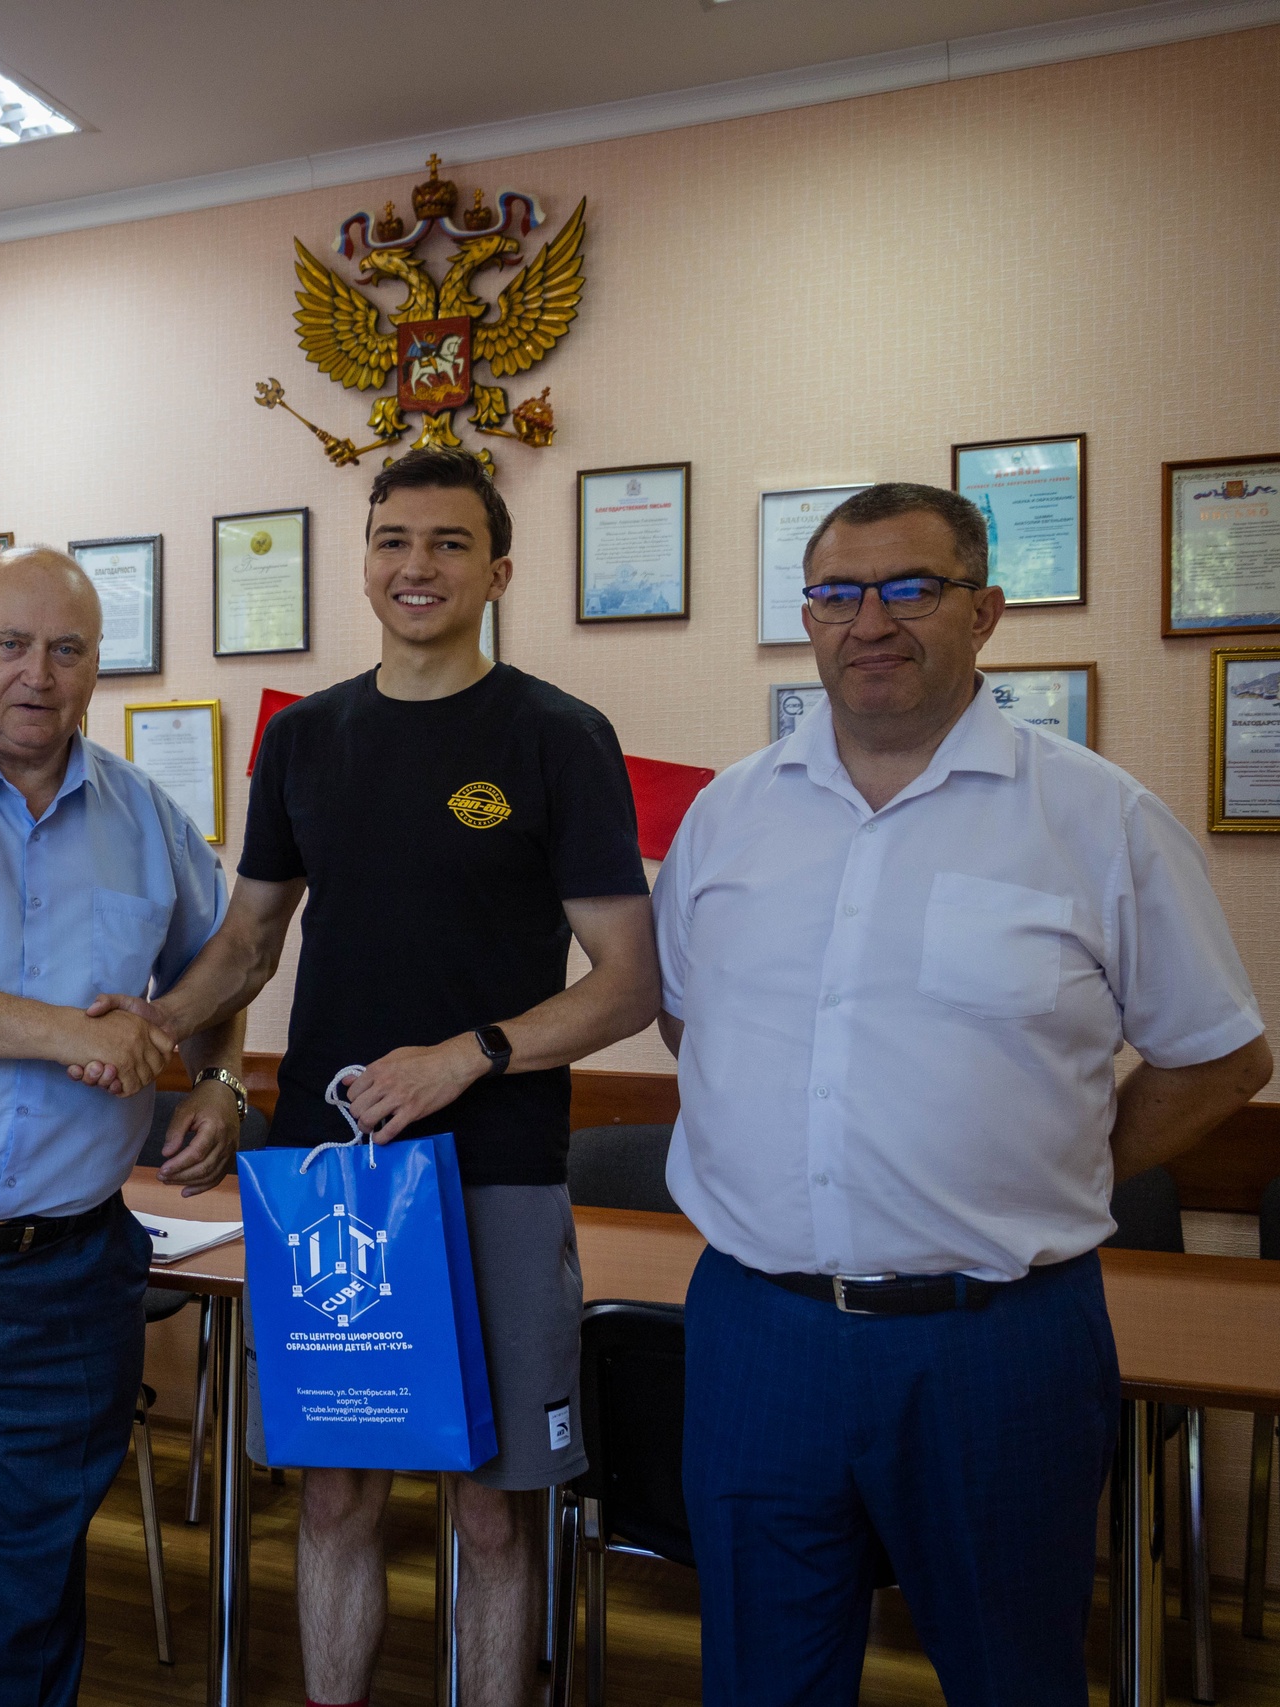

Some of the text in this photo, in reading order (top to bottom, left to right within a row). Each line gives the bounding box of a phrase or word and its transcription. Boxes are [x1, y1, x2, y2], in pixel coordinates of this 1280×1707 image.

[462, 784, 502, 801] ESTABLISHED
[321, 1280, 365, 1312] CUBE
[290, 1331, 403, 1342] СЕТЬ ЦЕНТРОВ ЦИФРОВОГО
[286, 1343, 344, 1351] ОБРАЗОВАНИЯ
[344, 1341, 372, 1352] ДЕТЕЙ
[297, 1387, 412, 1397] Княгинино, ул. Октябрьская, 22,
[336, 1397, 369, 1406] корпус 2
[301, 1406, 408, 1415] it-cube.knyaginino@yandex.ru
[306, 1414, 406, 1424] Княгининский университет
